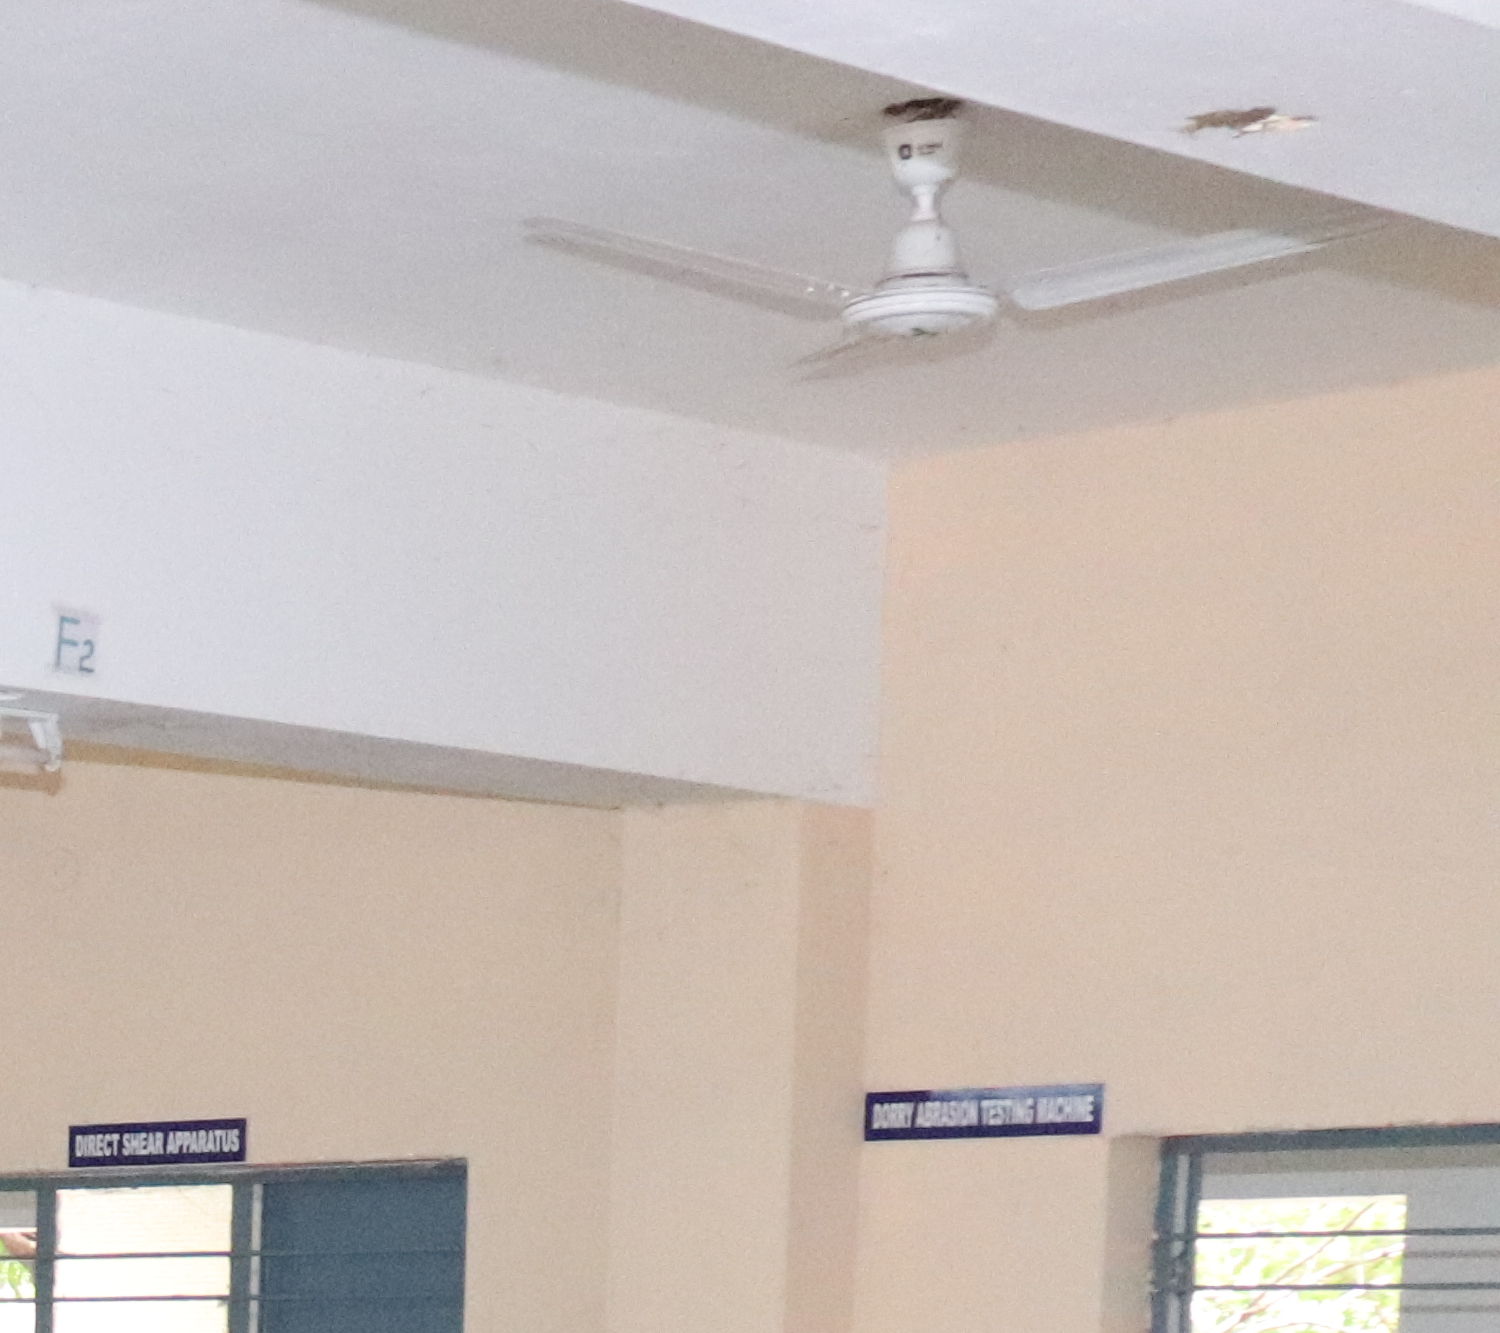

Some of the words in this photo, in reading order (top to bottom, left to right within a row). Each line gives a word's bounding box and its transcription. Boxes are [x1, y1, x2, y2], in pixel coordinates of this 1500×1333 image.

[55, 615, 95, 674] F2
[75, 1133, 120, 1157] DIRECT
[122, 1131, 164, 1156] SHEAR
[166, 1129, 240, 1154] APPARATUS
